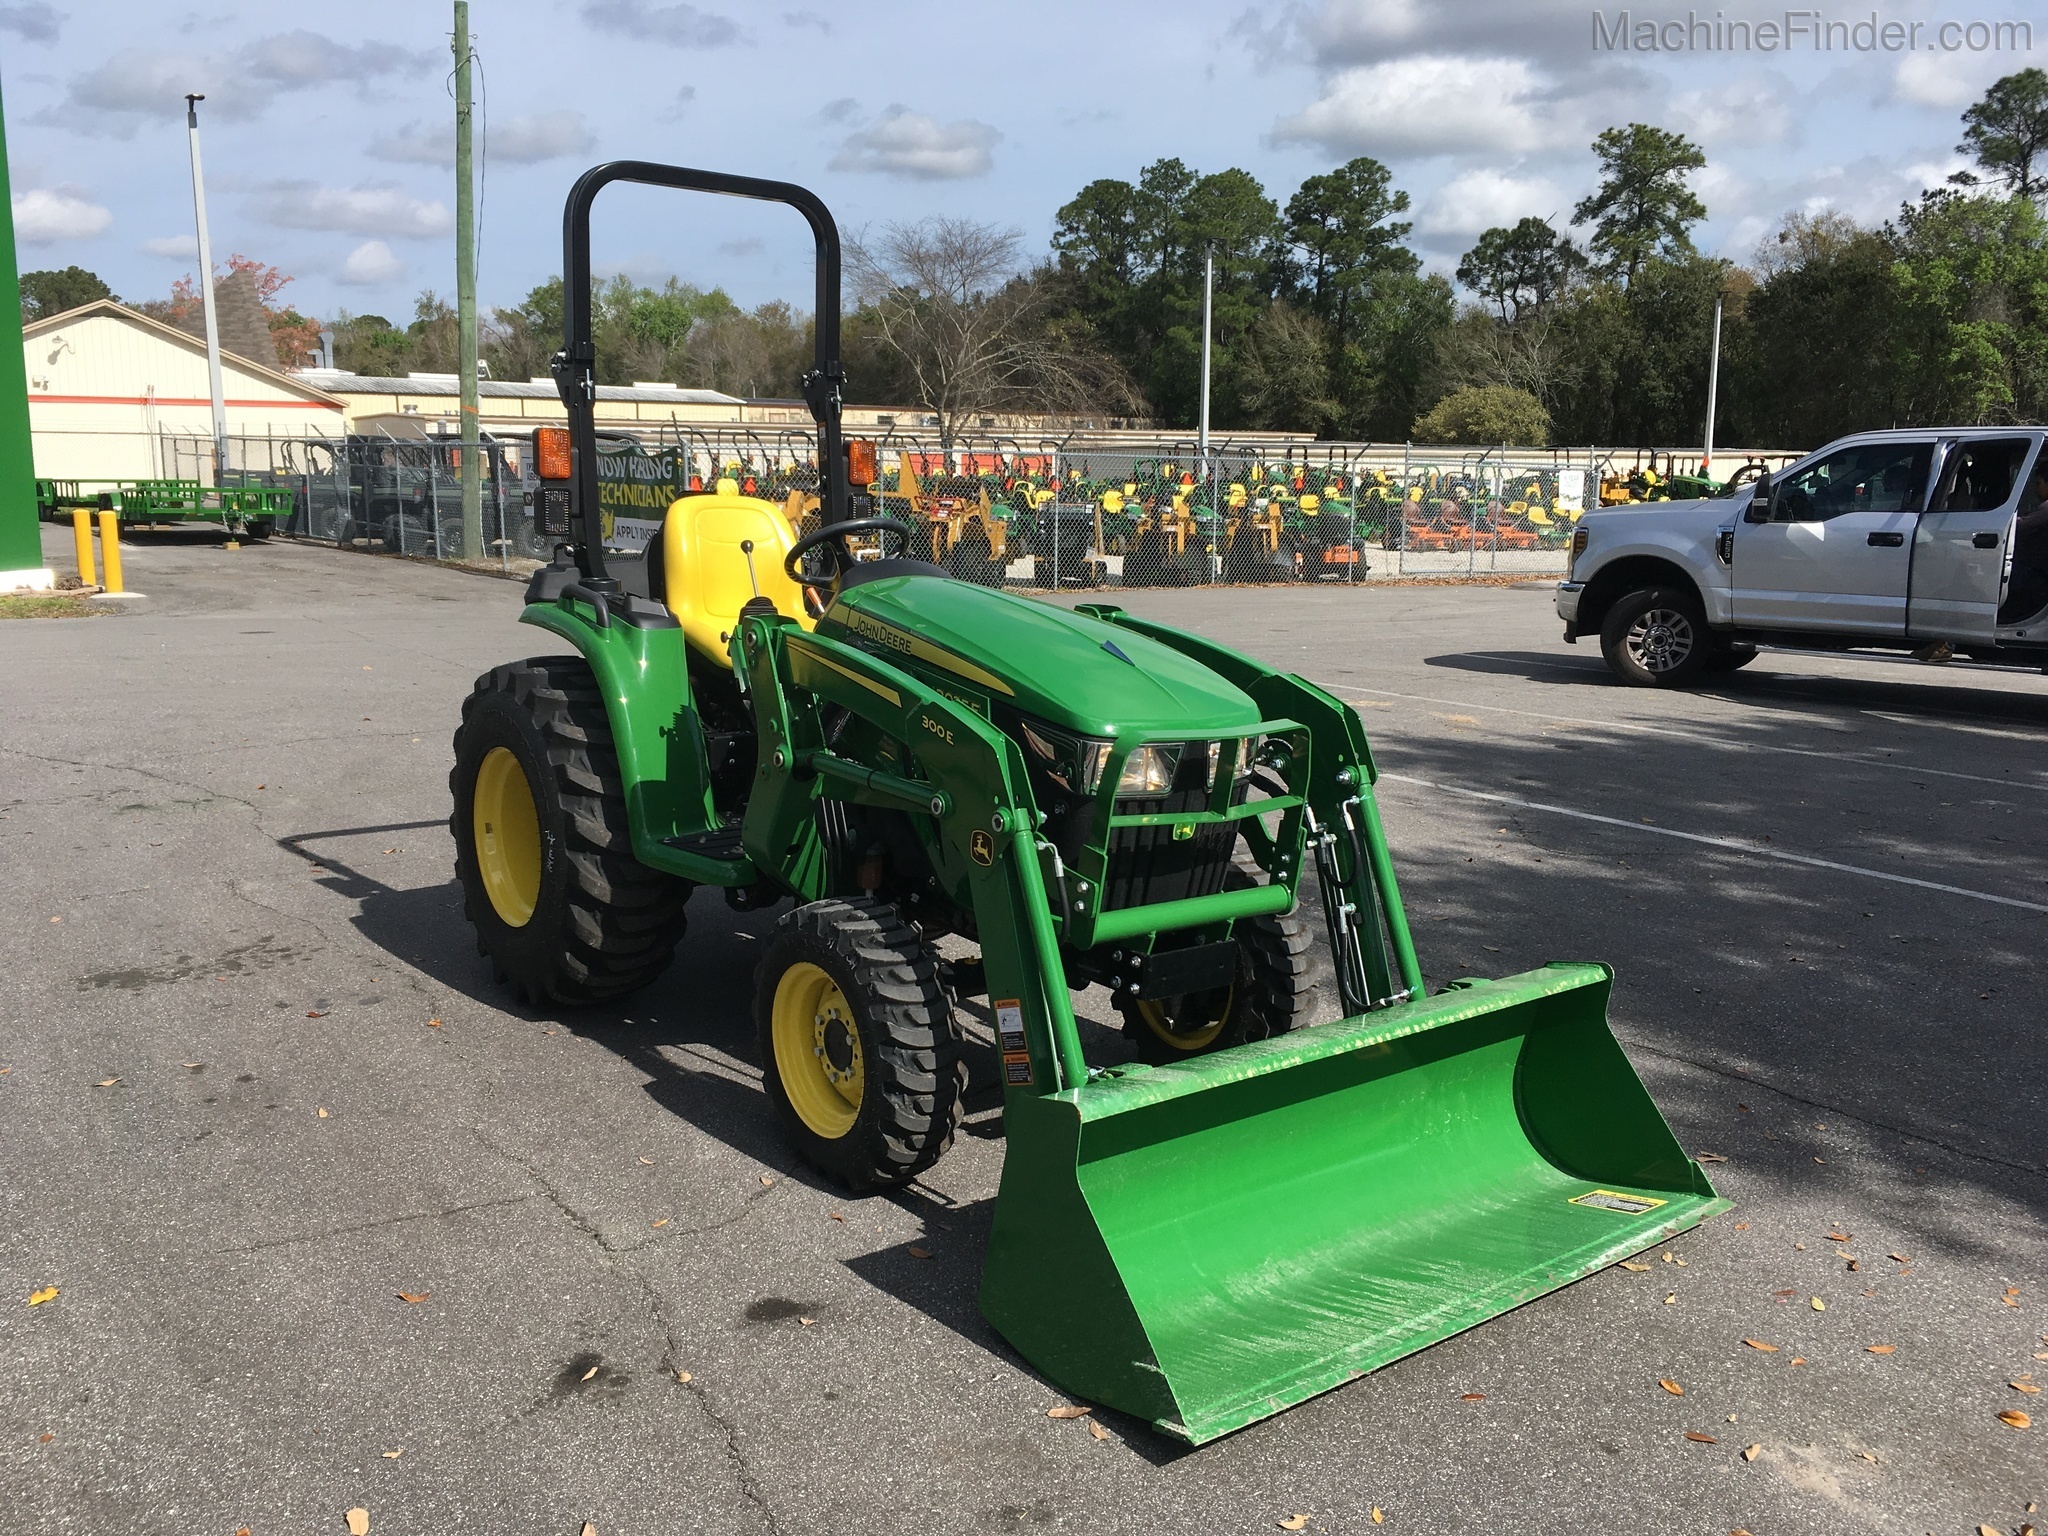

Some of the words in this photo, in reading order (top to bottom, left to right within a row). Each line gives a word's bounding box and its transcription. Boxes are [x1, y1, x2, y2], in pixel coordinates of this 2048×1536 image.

[596, 454, 627, 478] NOW
[616, 525, 640, 539] APPLY
[853, 616, 879, 640] JOHN
[879, 625, 912, 653] DEERE
